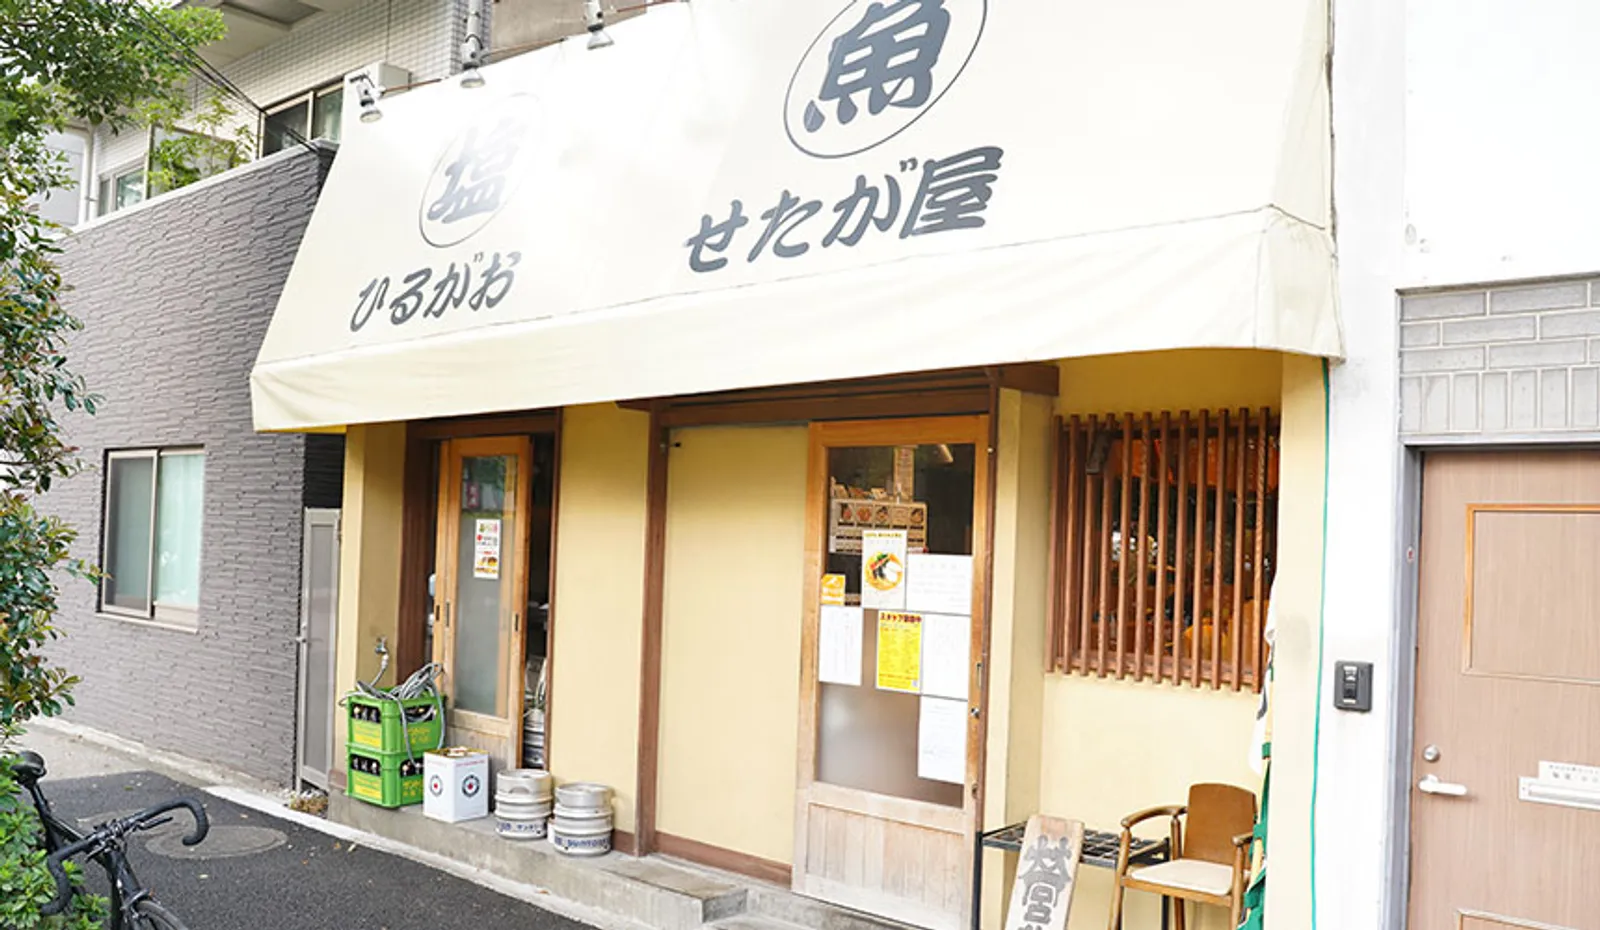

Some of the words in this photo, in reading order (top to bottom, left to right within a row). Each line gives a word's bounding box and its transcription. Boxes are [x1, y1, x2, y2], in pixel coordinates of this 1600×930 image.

[803, 0, 951, 133] 魚
[427, 116, 528, 224] 塩
[684, 146, 1004, 273] せたが屋
[350, 251, 522, 333] ひるがお
